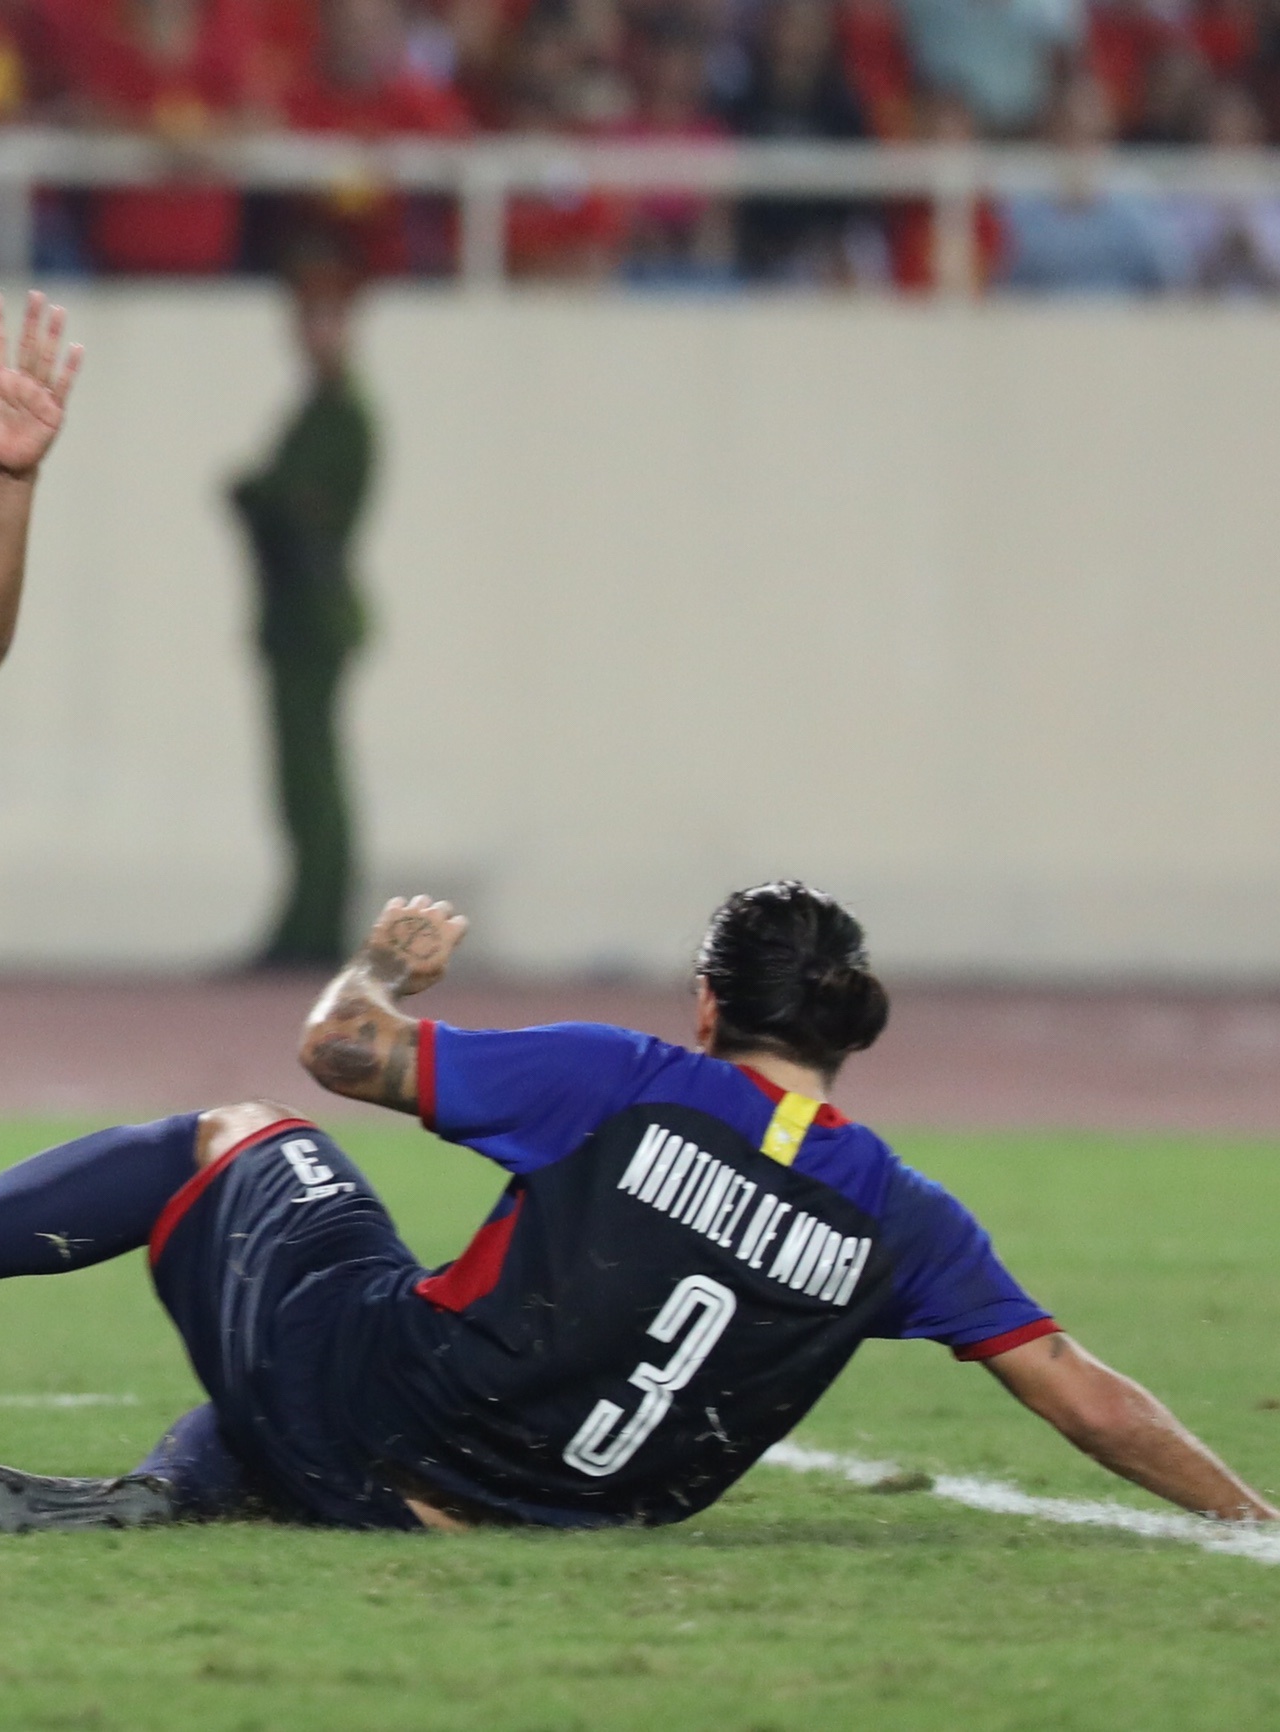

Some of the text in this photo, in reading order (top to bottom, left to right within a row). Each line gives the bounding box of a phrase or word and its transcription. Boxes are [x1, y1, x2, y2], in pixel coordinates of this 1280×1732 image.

[617, 1123, 873, 1306] MARTINEZ DE MURGA
[562, 1274, 737, 1476] 3
